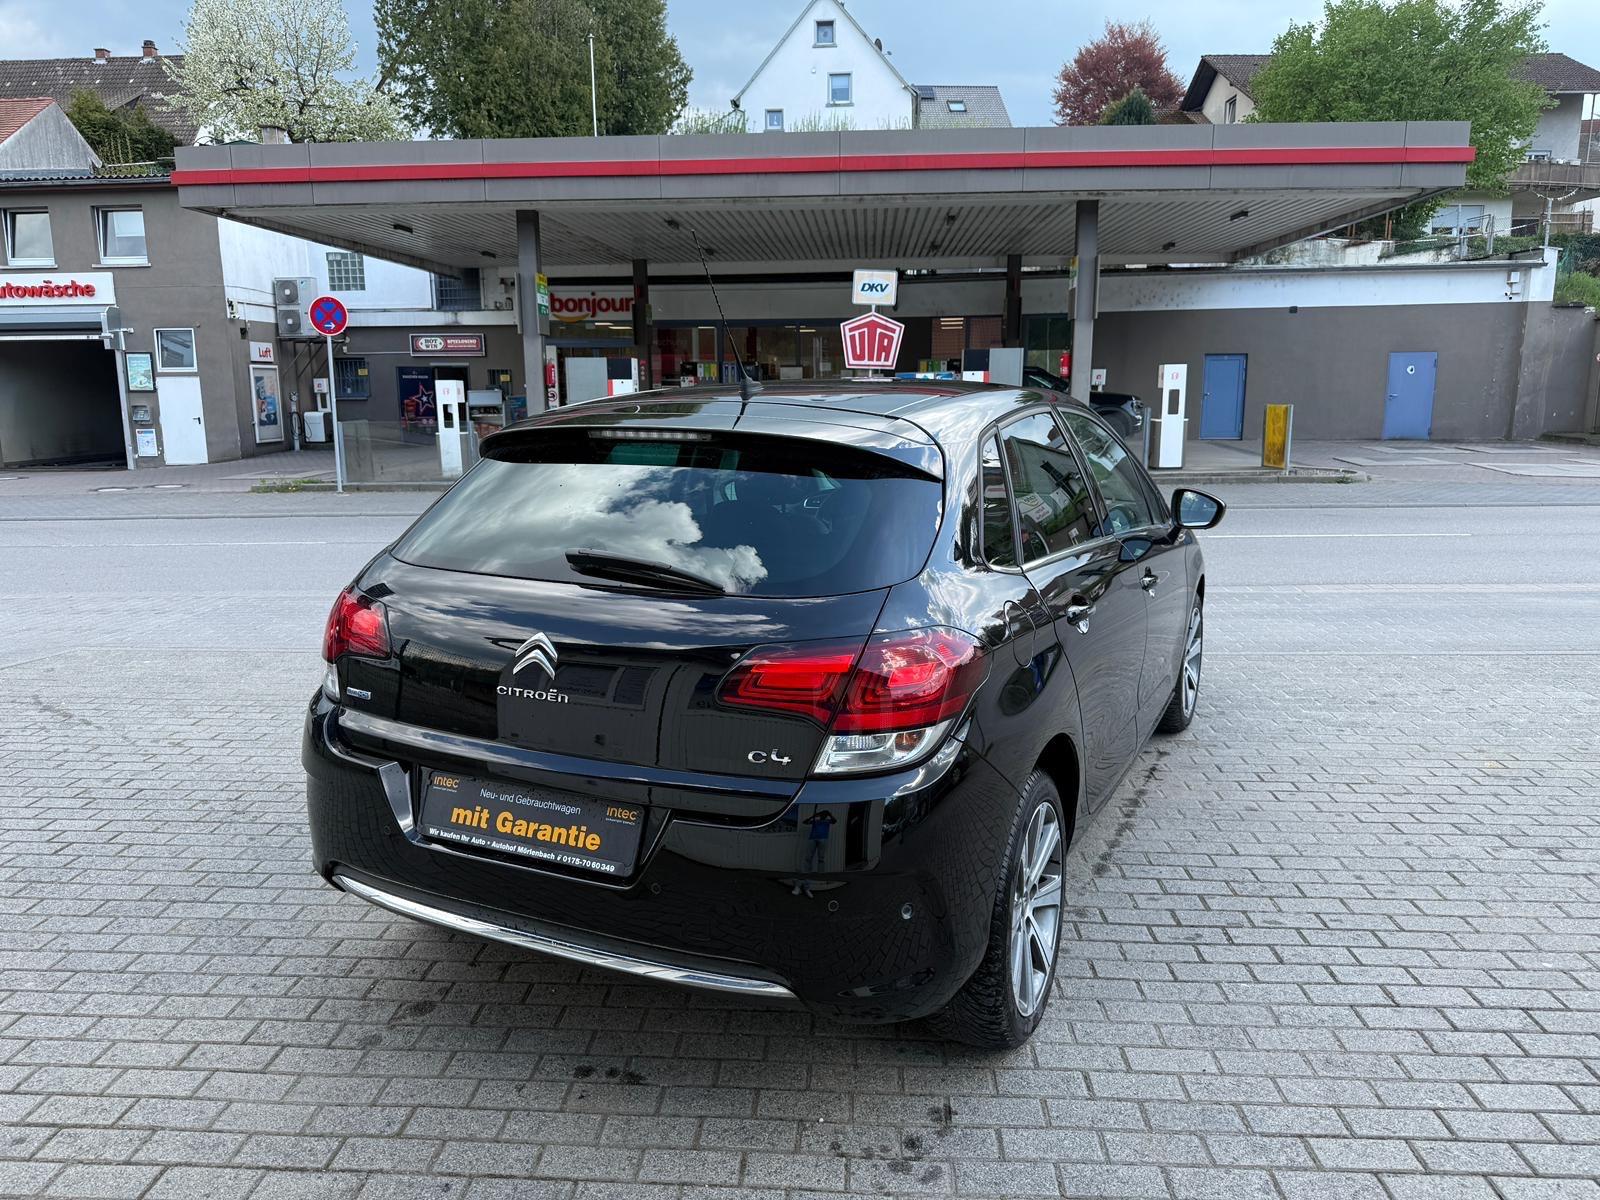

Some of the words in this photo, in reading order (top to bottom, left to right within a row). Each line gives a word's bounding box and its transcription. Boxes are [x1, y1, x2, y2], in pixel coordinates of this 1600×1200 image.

[860, 283, 889, 293] DKV
[550, 291, 634, 318] bonjour
[259, 342, 272, 358] Luft
[848, 319, 897, 362] UTA
[747, 748, 792, 766] C4
[480, 788, 498, 799] Neu-
[500, 793, 514, 803] und
[515, 794, 581, 815] Gebrauchtwagen
[450, 805, 490, 829] mit
[496, 811, 601, 851] Garantie
[429, 828, 440, 836] Wir
[440, 830, 460, 840] kaufen
[461, 834, 470, 842] Ihr
[471, 836, 486, 845] Auto
[491, 841, 517, 851] Autohof
[517, 845, 555, 860] Mörlenbach
